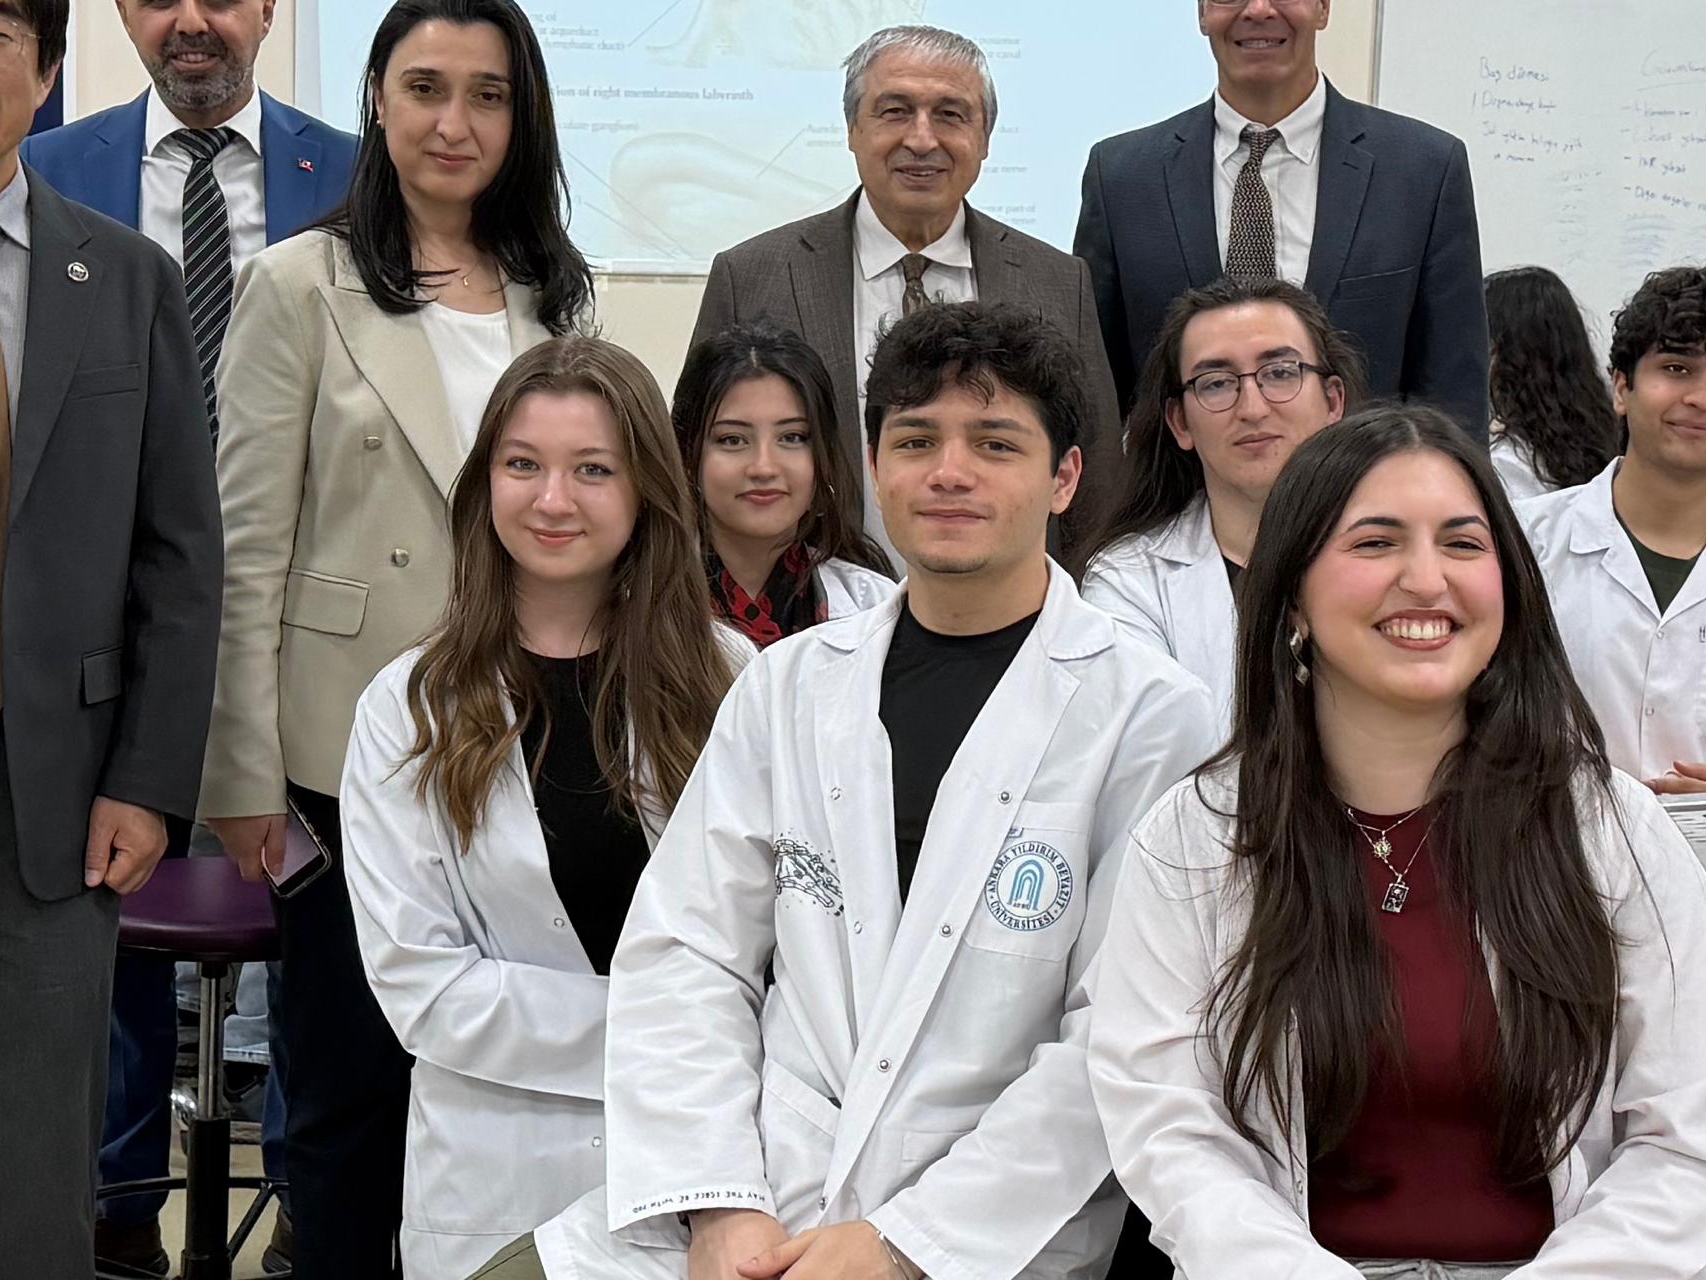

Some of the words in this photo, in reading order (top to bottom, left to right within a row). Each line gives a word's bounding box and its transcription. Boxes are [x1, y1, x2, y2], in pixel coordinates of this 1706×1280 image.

[987, 854, 1011, 893] ANKARA
[1011, 842, 1058, 863] YILDIRIM
[1055, 862, 1071, 910] BEYAZIT
[726, 1191, 743, 1199] THE
